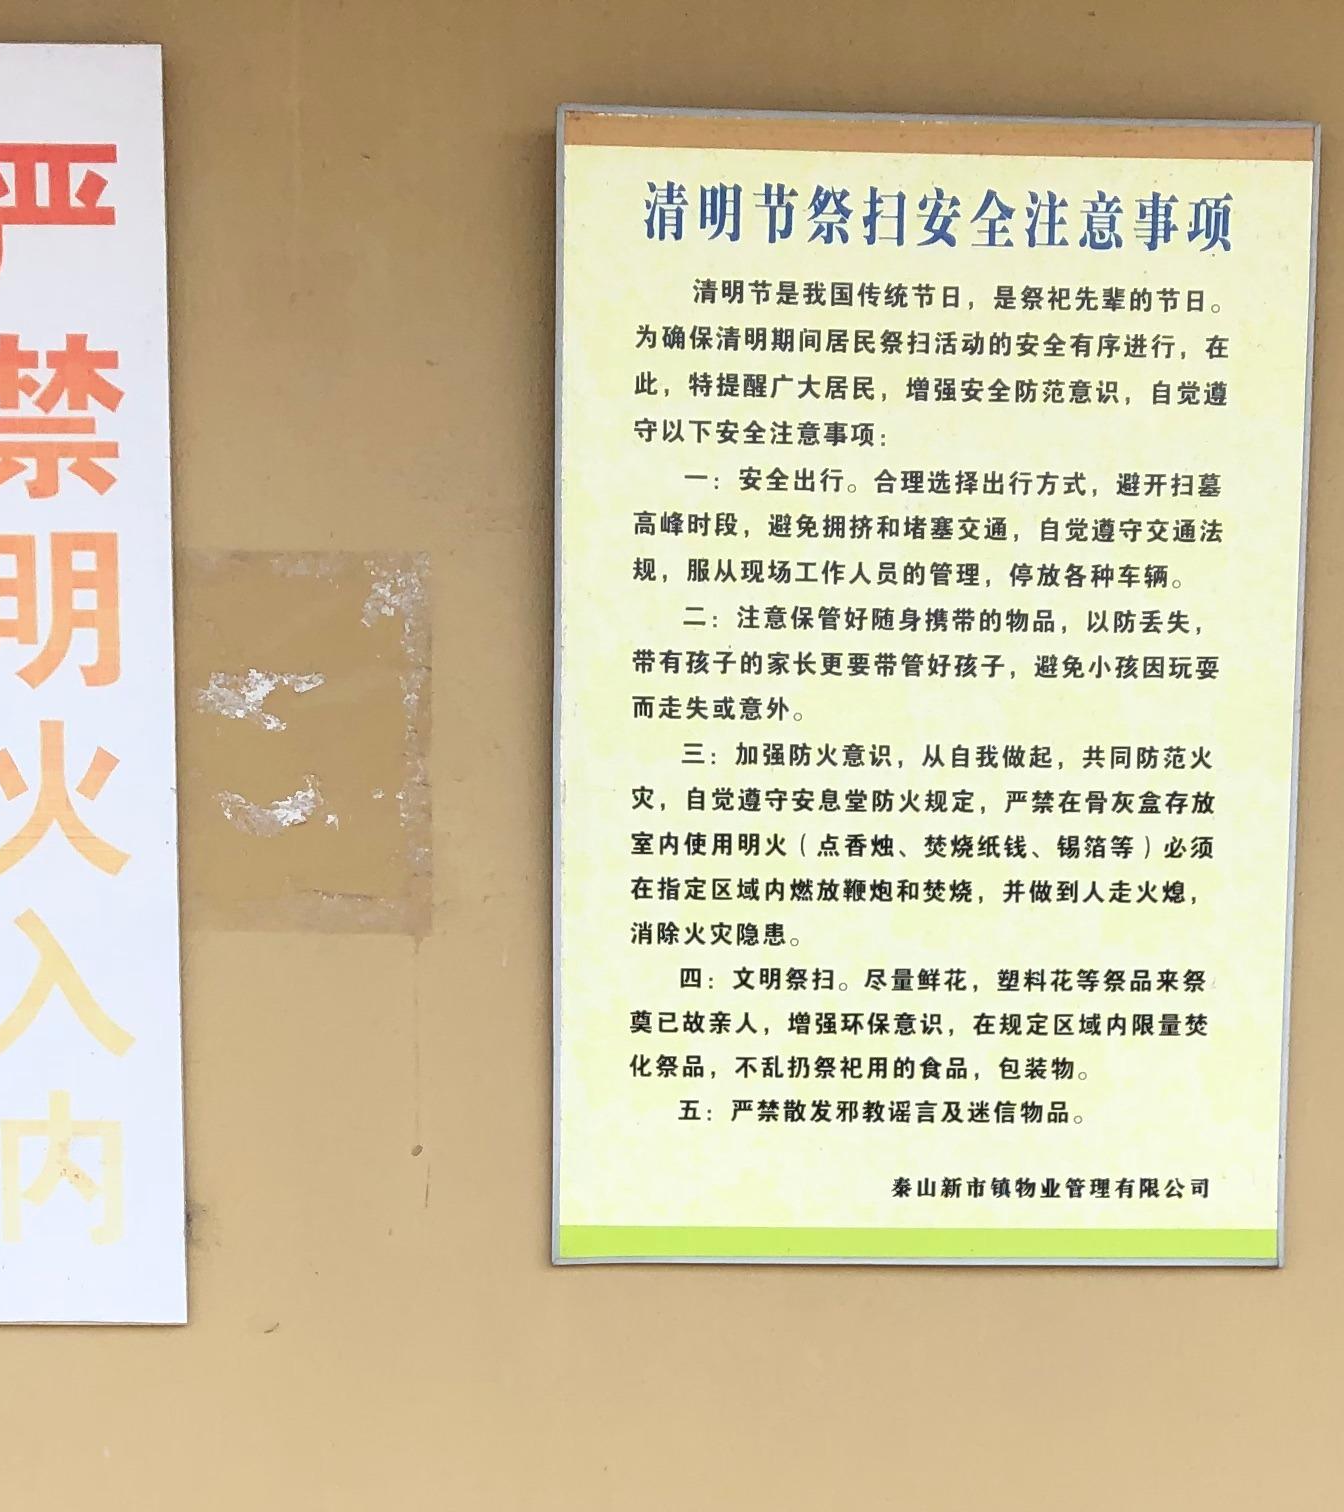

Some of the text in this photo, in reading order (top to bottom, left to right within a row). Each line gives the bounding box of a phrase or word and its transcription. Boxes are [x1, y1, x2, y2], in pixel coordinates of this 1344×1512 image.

[644, 181, 1233, 251] 清明节祭扫安全注意事项
[693, 278, 1222, 314] 清明节是我国传统节日，是祭祀先辈的节日。
[635, 324, 1229, 360] 为确保清明期间居民祭扫活动的安全有序进行，在
[634, 371, 1228, 406] 此，特提醒广大居民，增强安全防范意识，自觉遵
[633, 511, 1223, 543] 高峰时段，避免拥挤和堵塞交通，自觉遵守交通法
[632, 557, 1181, 589] 规，服从现场工作人员的管理，停放各种车辆。
[632, 649, 1220, 680] 带有孩子的家长更要带管好孩子，避免小孩因玩耍
[632, 695, 803, 722] 而走失或意外。
[631, 785, 1216, 815] 灾，自觉遵守安息堂防火规定，严禁在骨灰盒存放
[630, 876, 1197, 905] 在指定区域内燃放鞭炮和焚烧，并做到人走火熄，
[630, 921, 800, 947] 消除火灾隐患。
[629, 1009, 1209, 1037] 奠已故亲人，增强环保意识，在规定区域内限量焚
[629, 1054, 1088, 1081] 化祭品，不乱扔祭祀用的食品，包装物。
